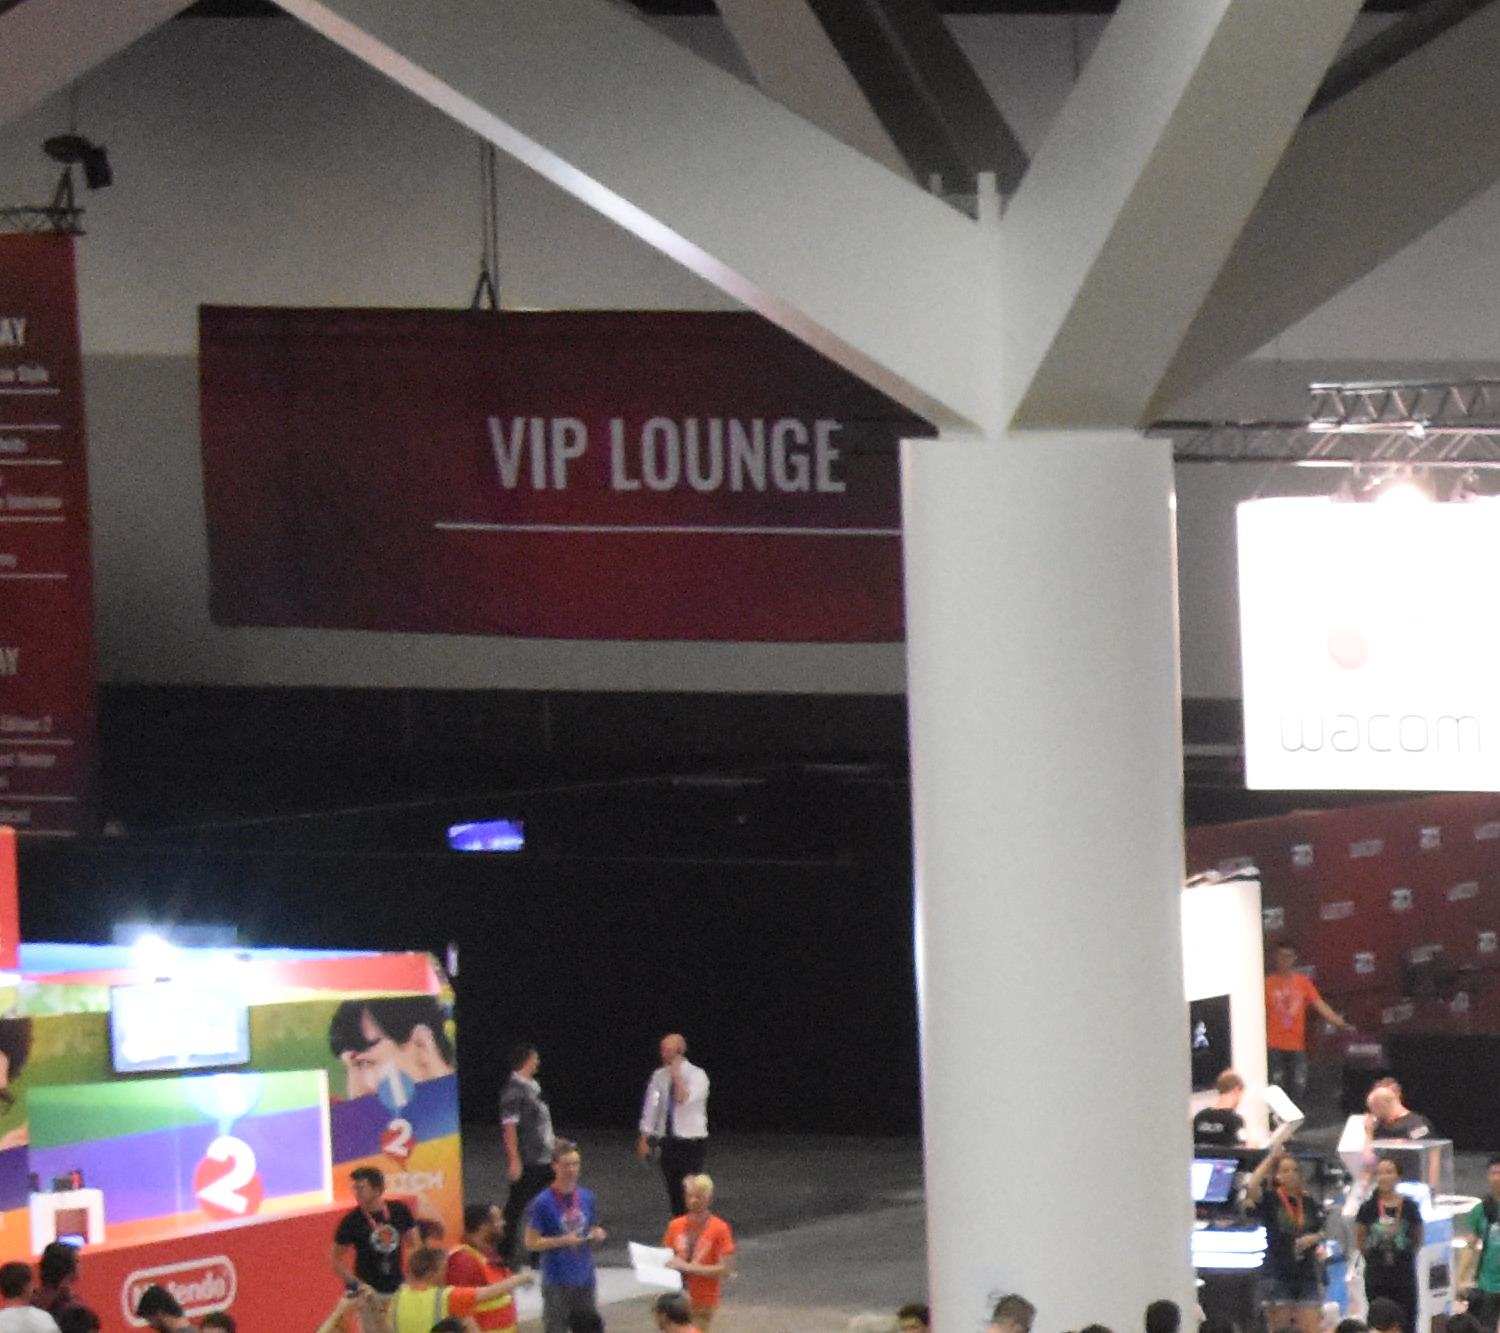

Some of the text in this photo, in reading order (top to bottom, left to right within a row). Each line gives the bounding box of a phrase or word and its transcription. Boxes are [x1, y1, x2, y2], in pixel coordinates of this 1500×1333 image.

[488, 416, 847, 493] VIP LOUNGE
[1281, 714, 1481, 752] wacom
[382, 1118, 414, 1157] 2
[196, 1135, 257, 1215] 2
